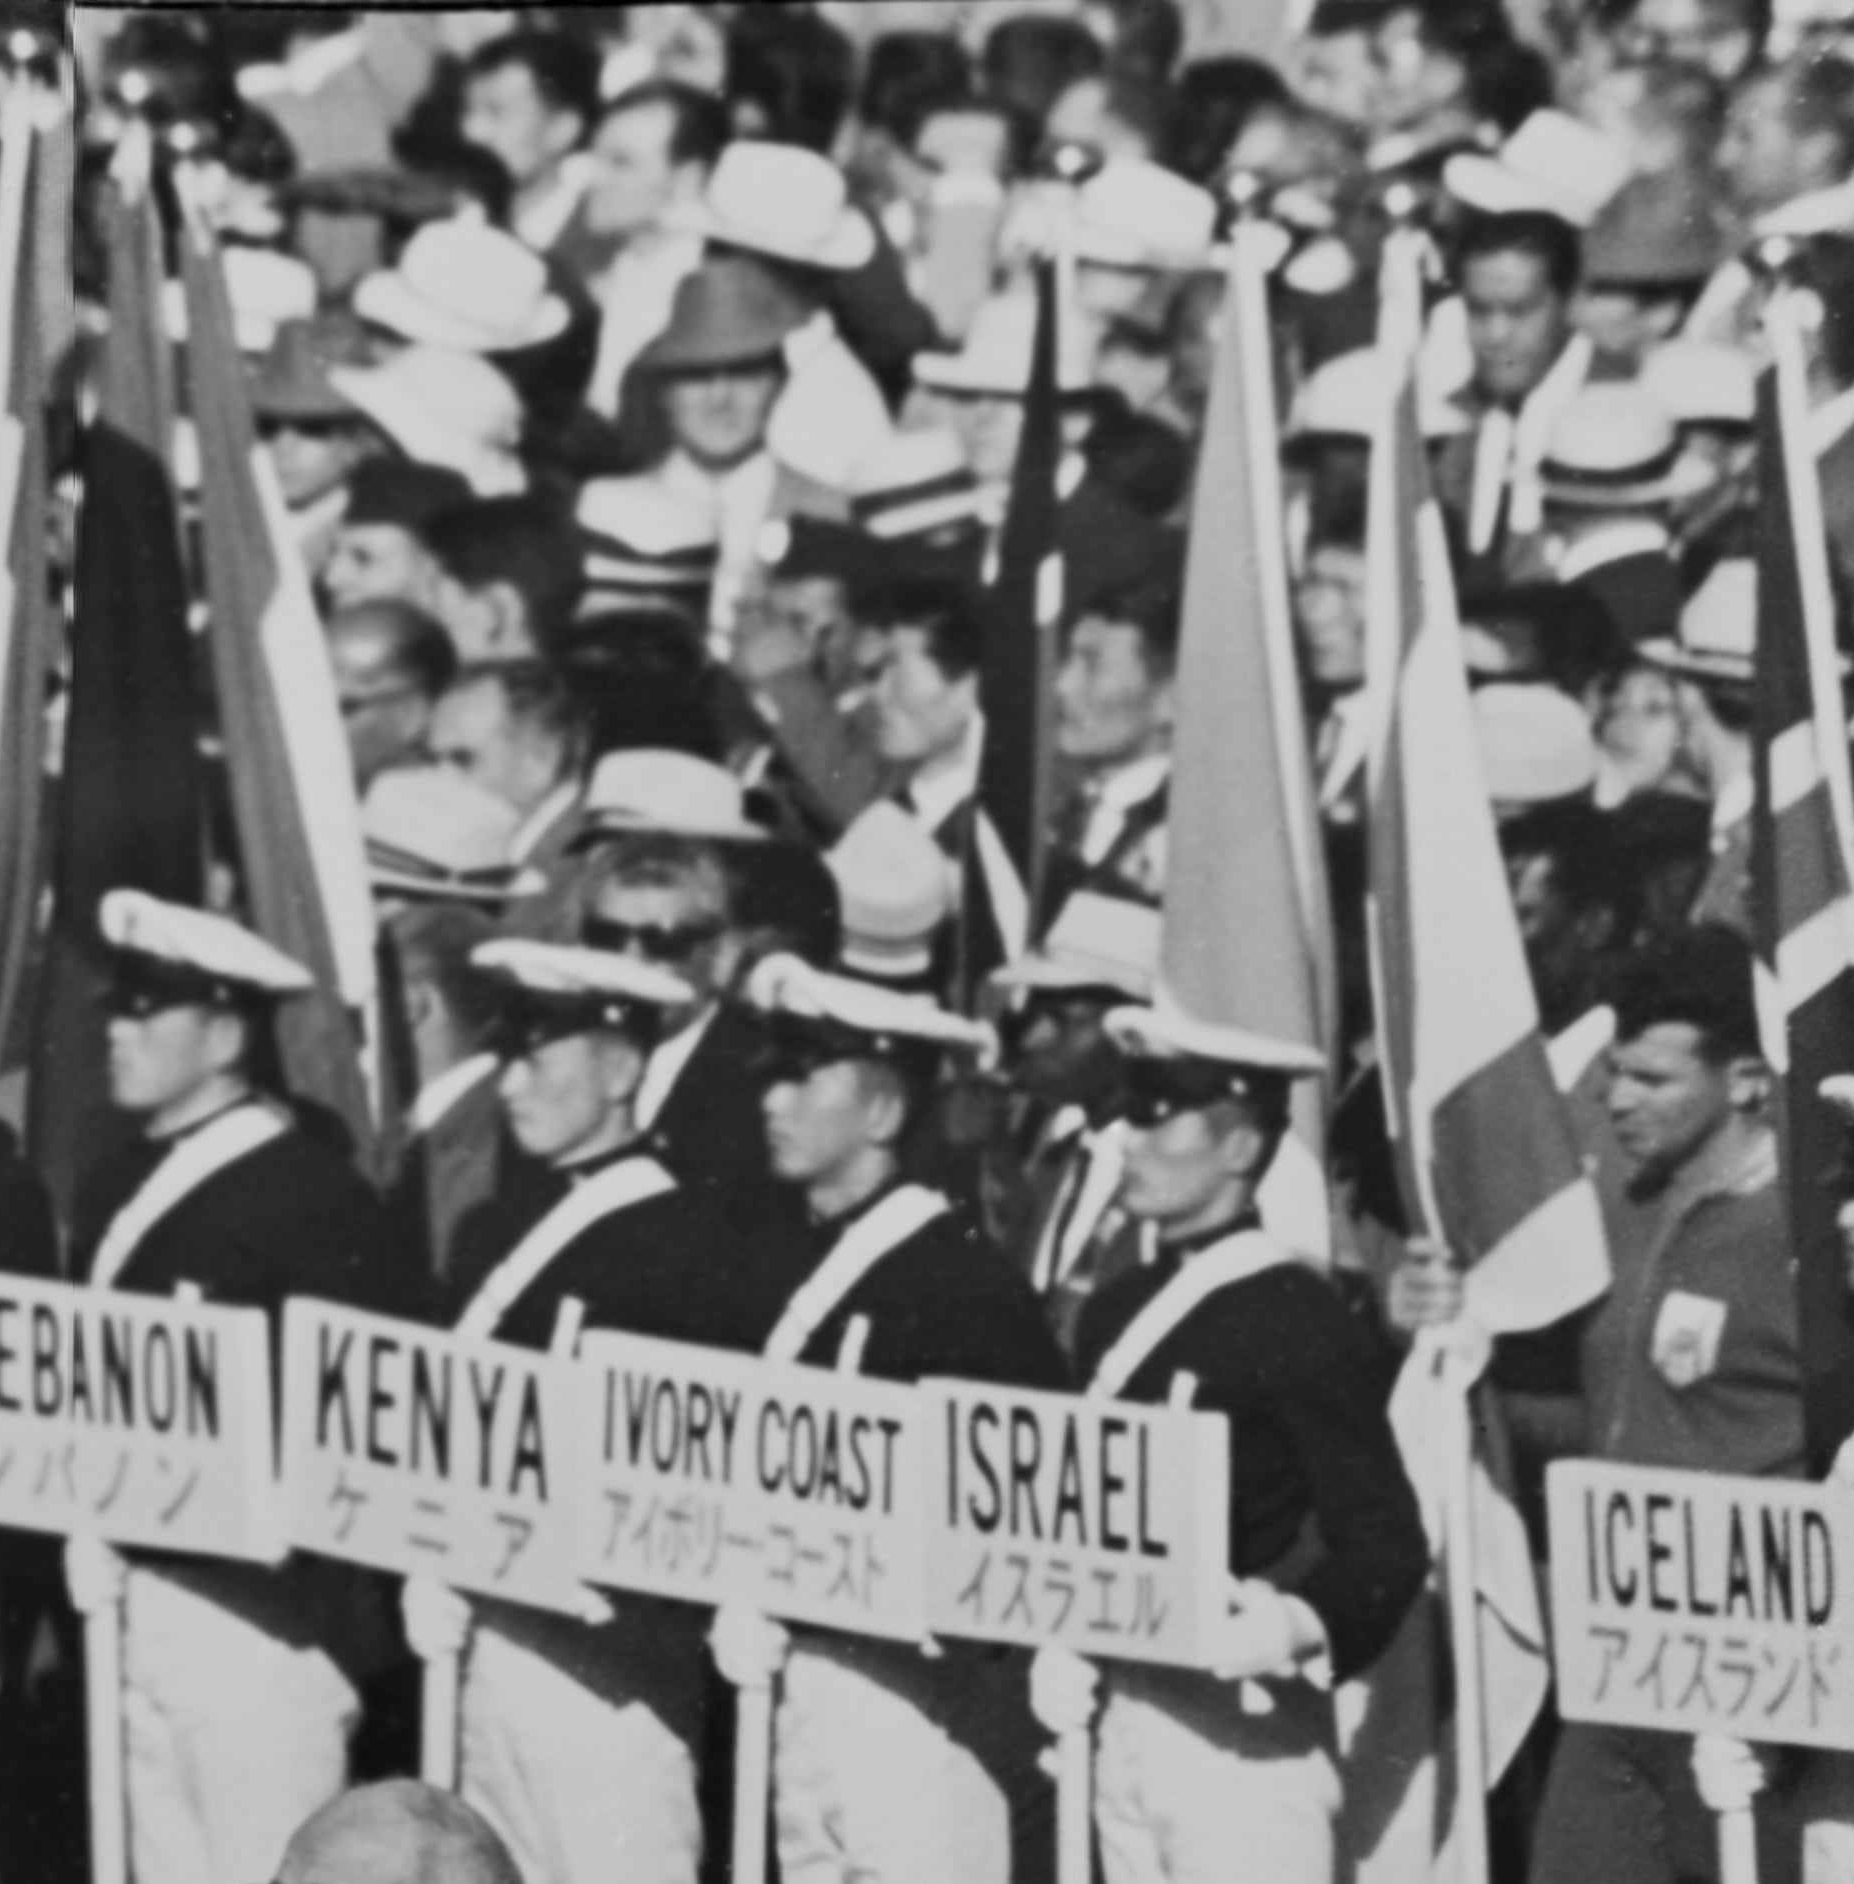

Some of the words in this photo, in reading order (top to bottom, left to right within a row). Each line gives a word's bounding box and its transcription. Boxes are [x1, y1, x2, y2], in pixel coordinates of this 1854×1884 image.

[315, 1322, 550, 1505] KENYA
[603, 1367, 742, 1485] IVORY
[755, 1397, 902, 1517] COAST
[329, 1475, 533, 1581] ケニア
[945, 1397, 1169, 1558] ISRAEL
[601, 1487, 887, 1600] アイボリーコースト
[956, 1550, 1170, 1642] イスラエル
[1586, 1488, 1835, 1627] ICELAND
[1587, 1625, 1842, 1729] アイスランド
